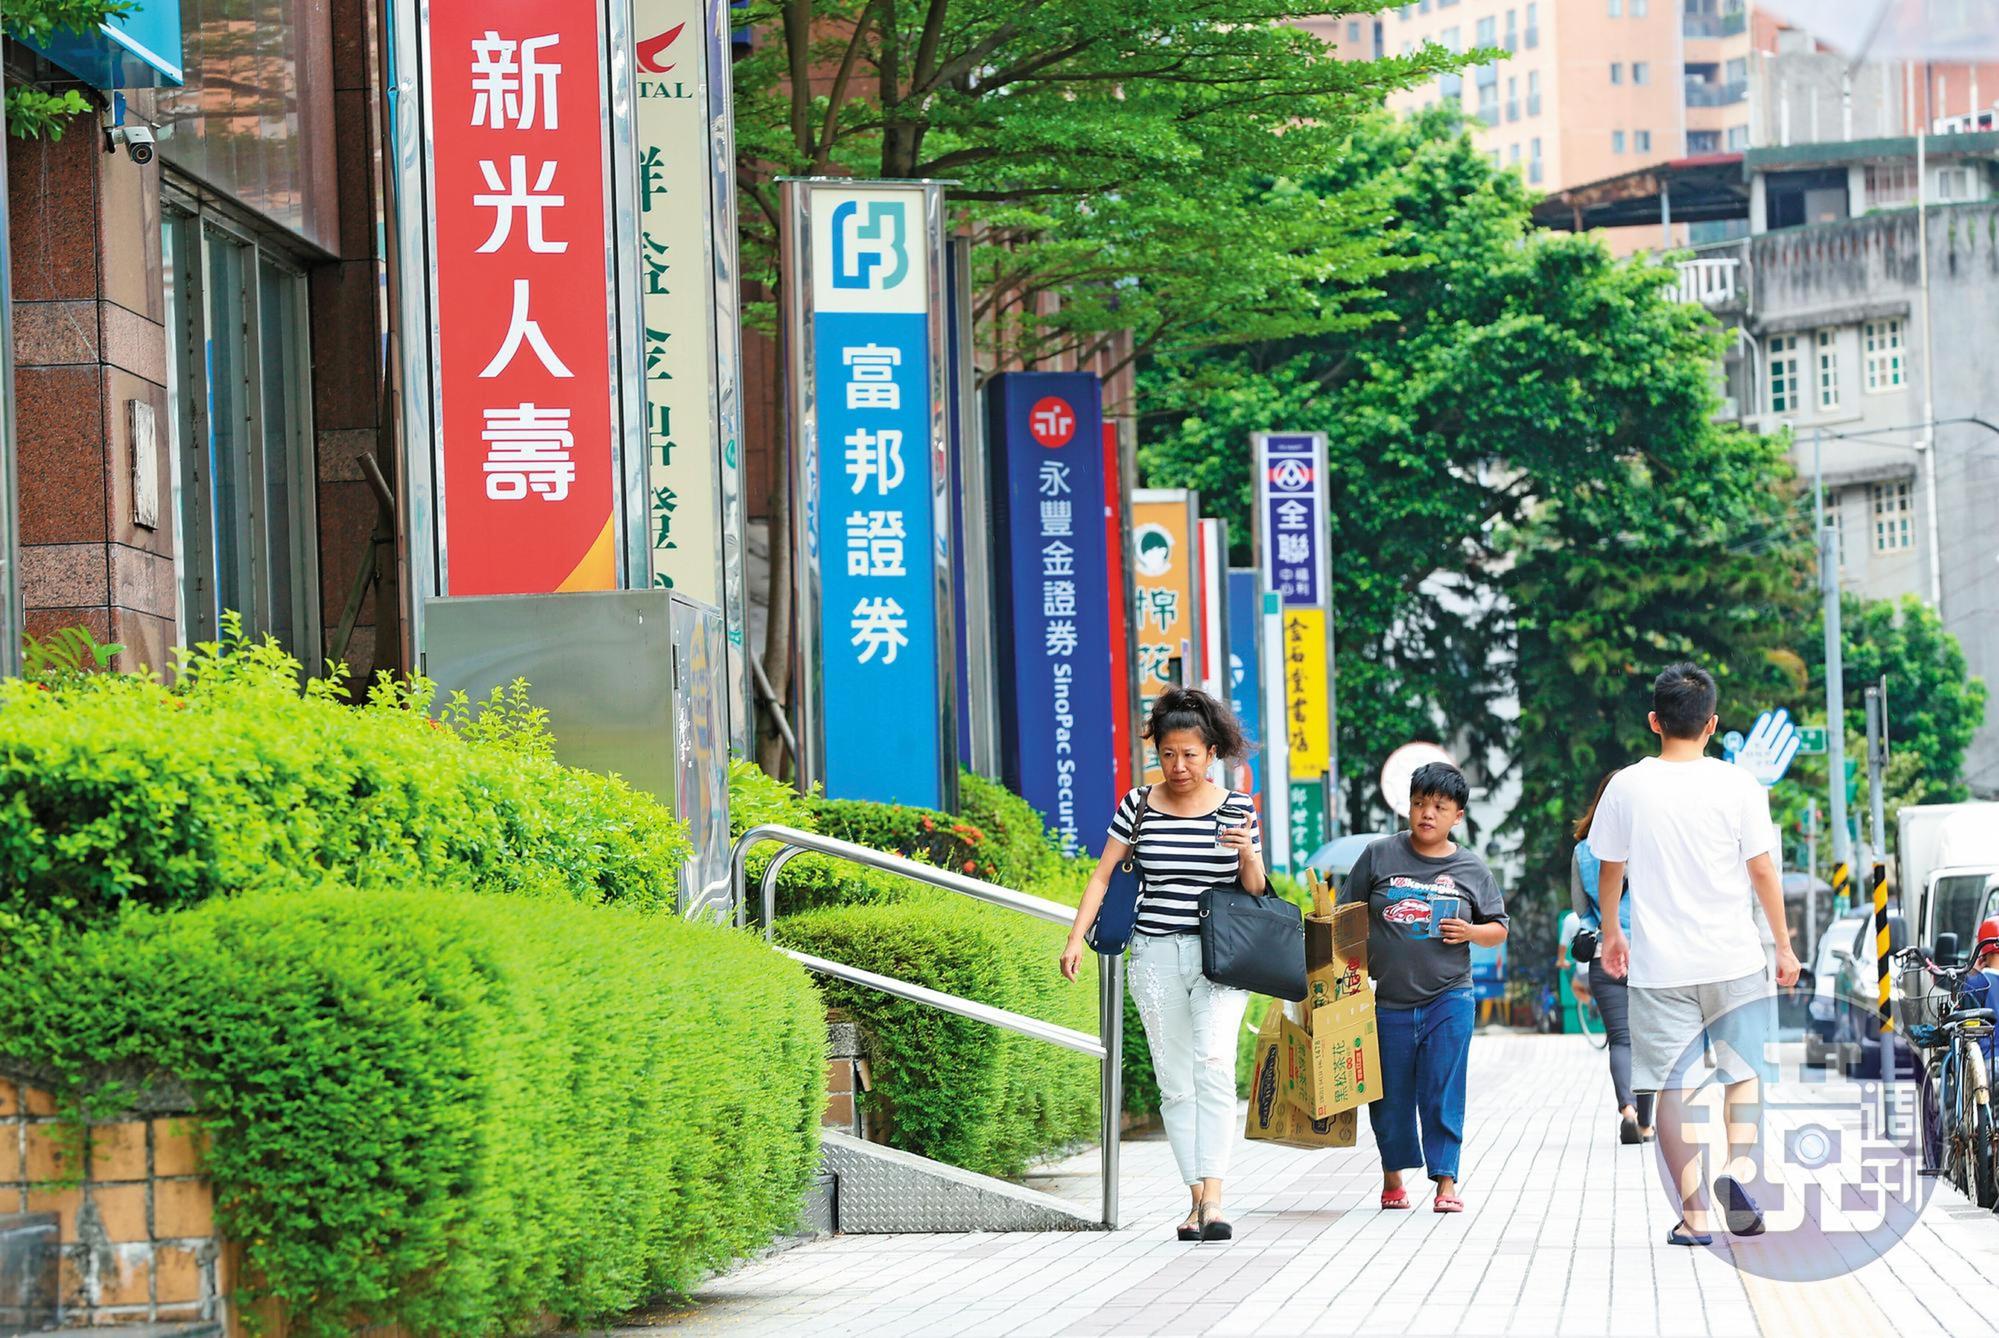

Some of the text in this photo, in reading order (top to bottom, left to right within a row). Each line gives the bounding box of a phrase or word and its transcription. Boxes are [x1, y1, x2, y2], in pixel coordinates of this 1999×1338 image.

[637, 81, 693, 99] TAL
[470, 31, 576, 502] 新光人壽
[842, 343, 909, 665] 富邦證券
[1276, 499, 1309, 564] 全聯
[1039, 460, 1079, 658] 永豐金證券
[1053, 662, 1074, 755] SinoPac
[1332, 1040, 1349, 1103] 黑松茶花
